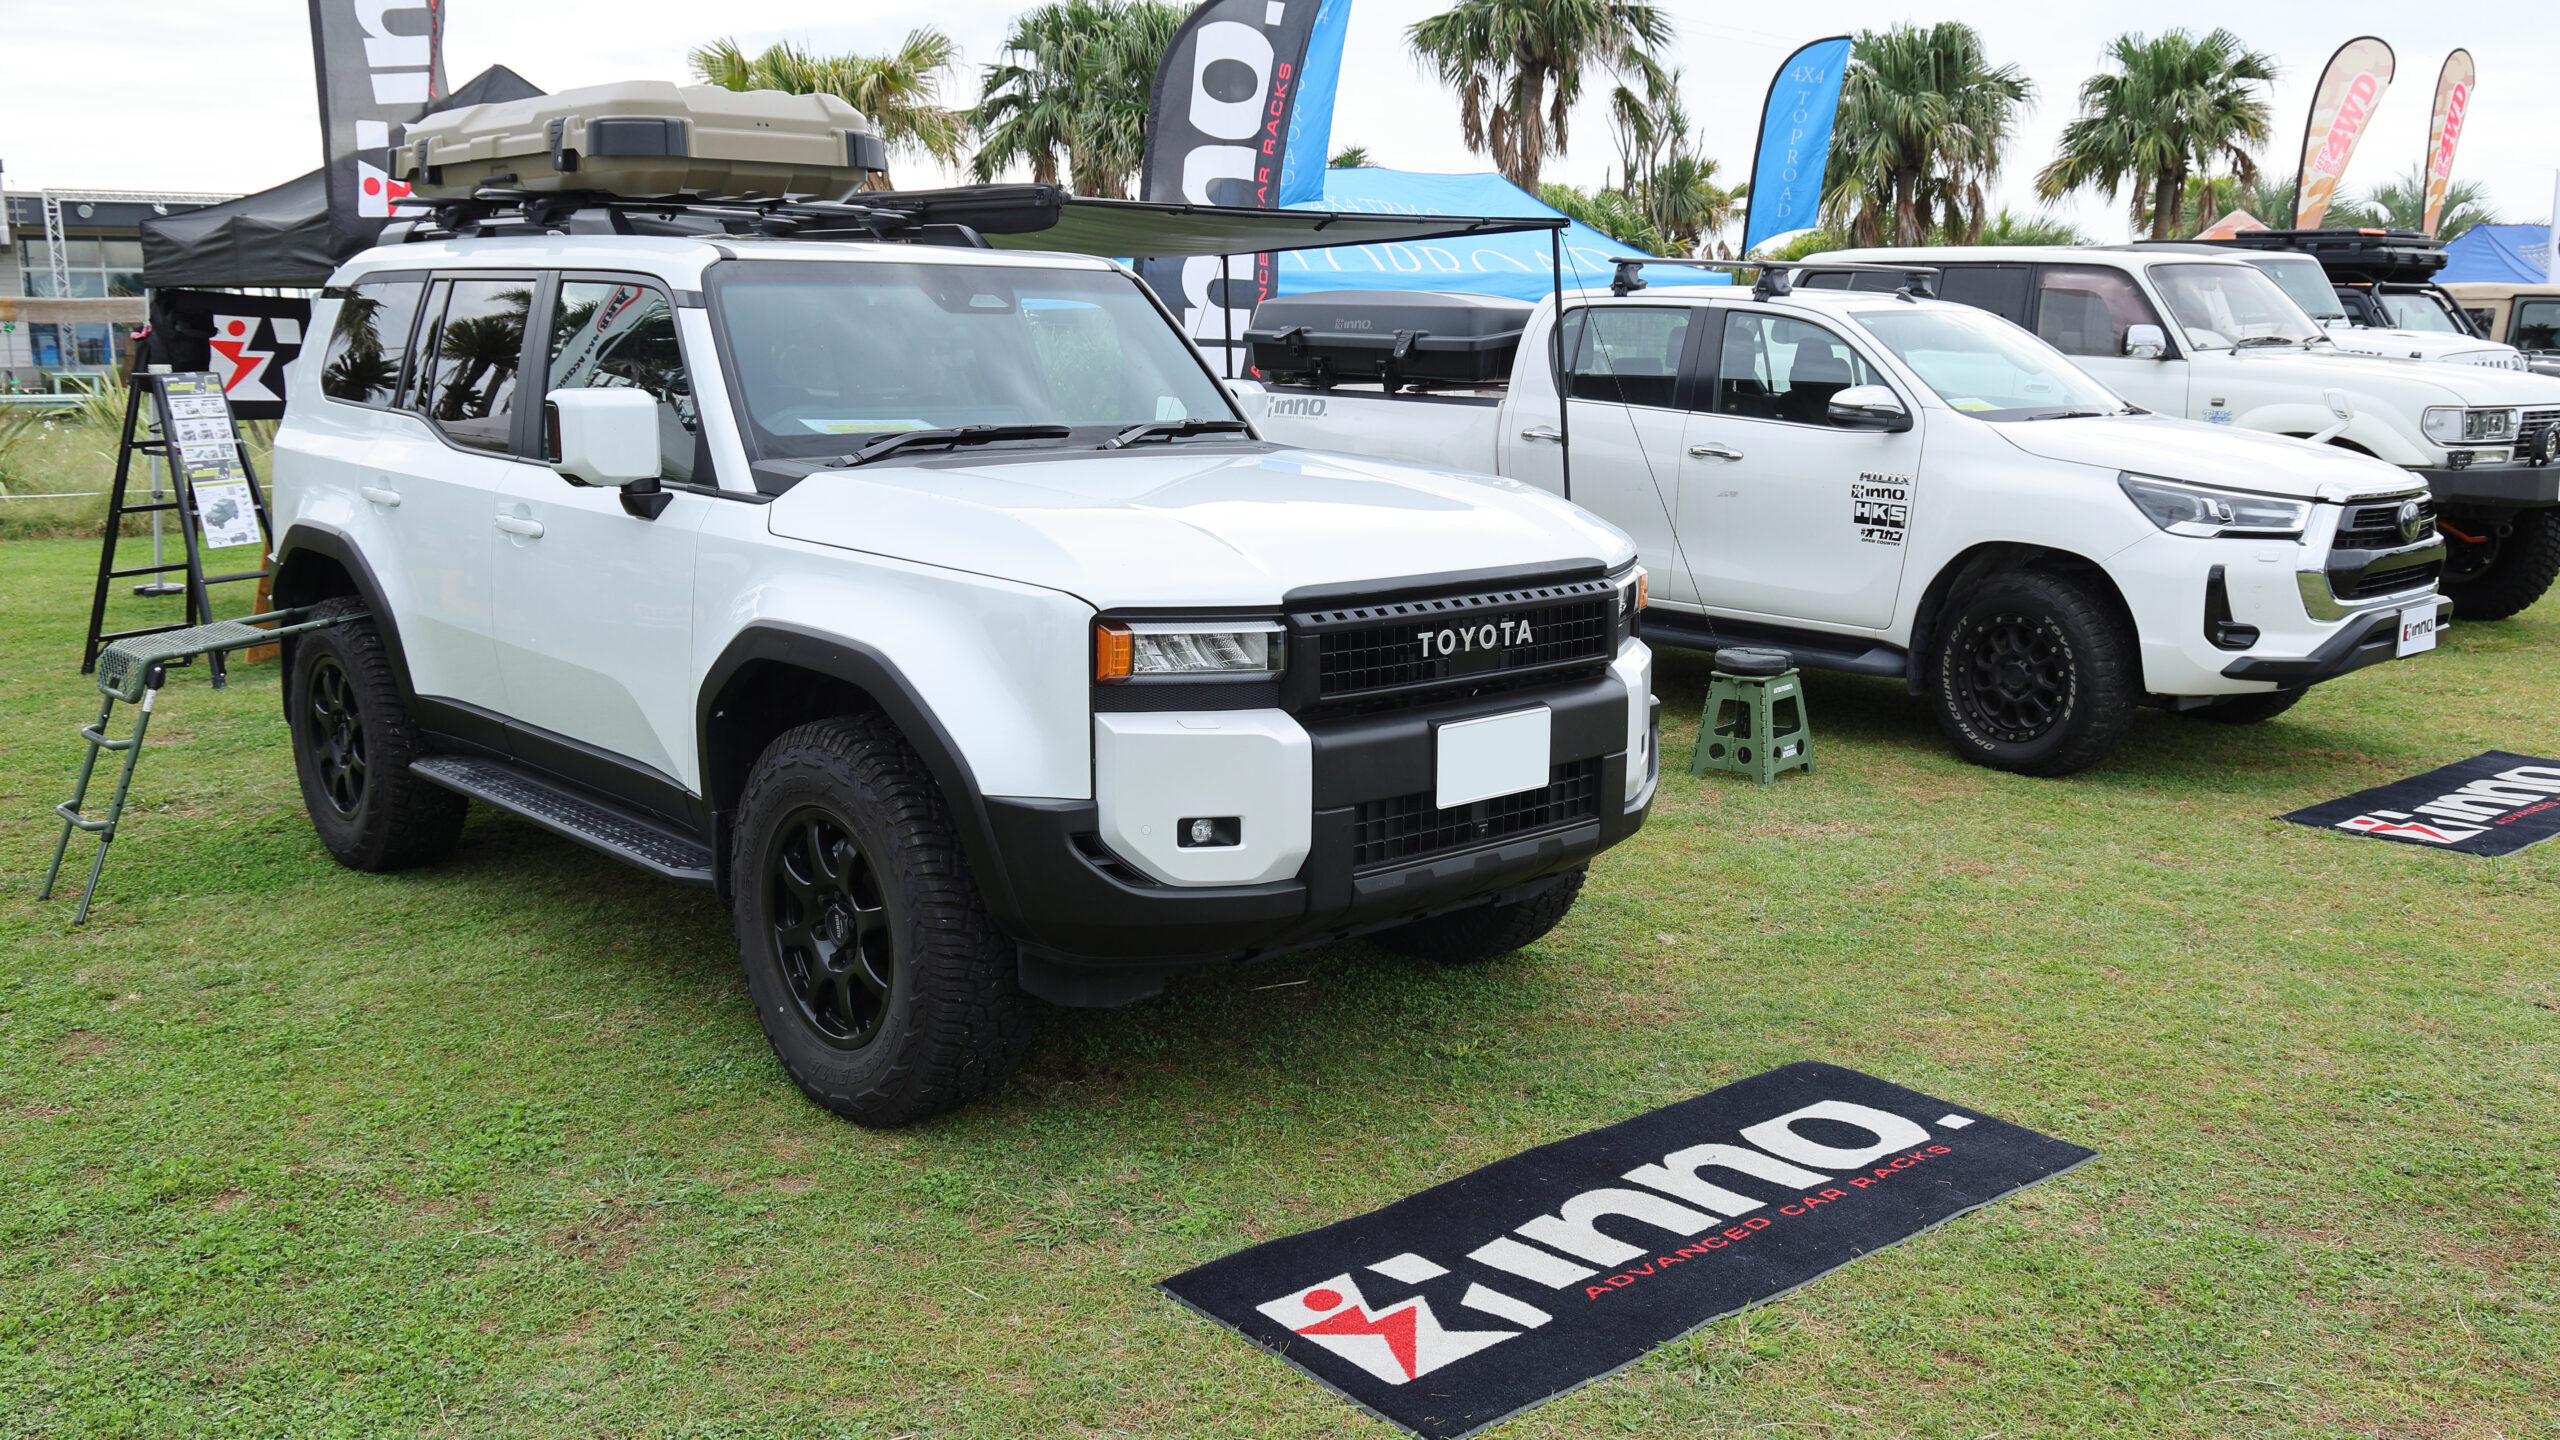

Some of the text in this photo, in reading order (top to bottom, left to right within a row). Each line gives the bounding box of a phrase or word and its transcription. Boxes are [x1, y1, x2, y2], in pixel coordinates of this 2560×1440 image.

[1790, 65, 1826, 85] 4X4
[1262, 62, 1293, 156] RACKS
[2327, 73, 2378, 160] 4WD
[2440, 83, 2467, 164] 4WD
[1776, 90, 1812, 218] TOPROAD
[1257, 167, 1272, 208] AR
[1274, 398, 1328, 417] inno.
[1854, 501, 1907, 525] HKS
[1865, 487, 1908, 502] inno.
[1417, 619, 1534, 658] TOYOTA
[1942, 645, 1962, 721] COUNTRY
[2045, 615, 2076, 721] TOYO TIRES
[1959, 723, 1996, 751] OPEN
[2494, 801, 2560, 825] ADVANCED
[1466, 1100, 1976, 1290] inno.
[1585, 1144, 1952, 1301] ADVANCED CAR RACKS
